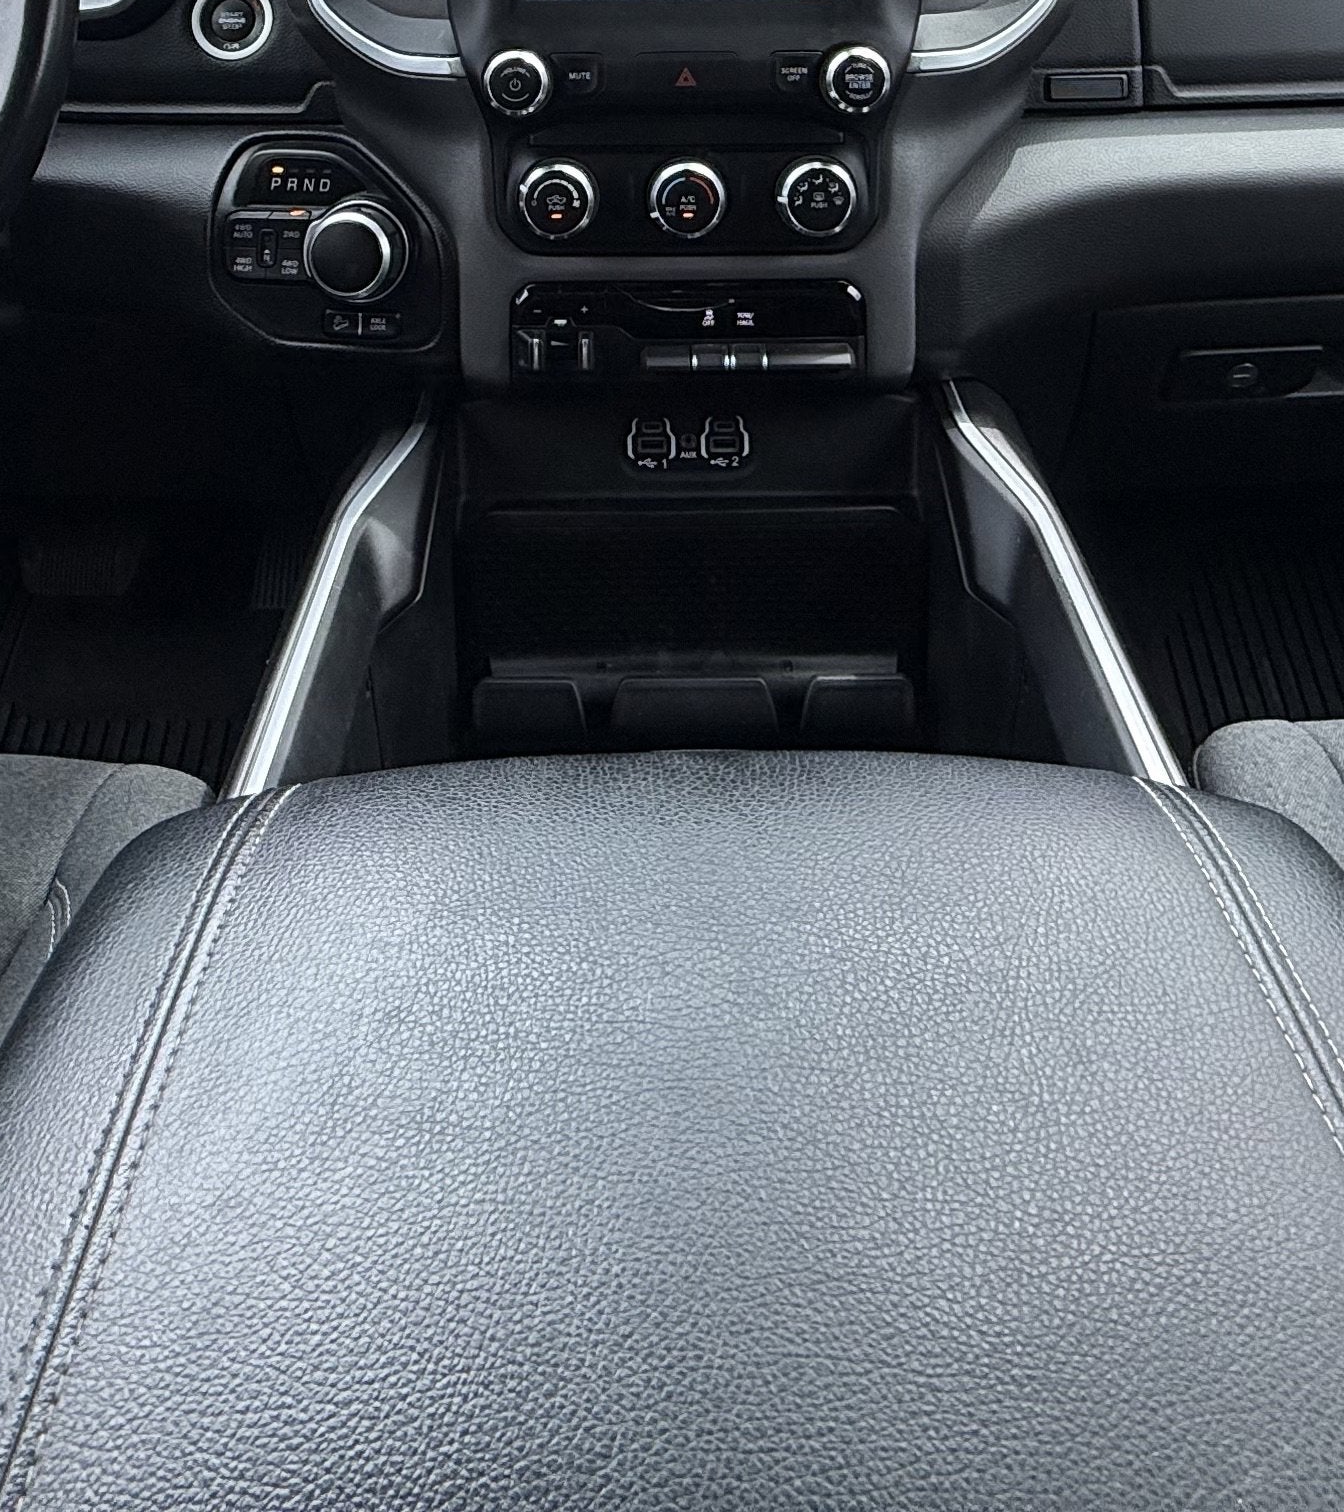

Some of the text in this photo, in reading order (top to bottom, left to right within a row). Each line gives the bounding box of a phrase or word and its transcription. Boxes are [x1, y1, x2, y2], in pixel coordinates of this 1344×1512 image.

[780, 66, 809, 75] SCREEN
[568, 71, 592, 80] MUTE
[786, 74, 801, 82] OFF
[681, 195, 696, 203] A/C
[810, 201, 828, 209] PUSH
[232, 231, 253, 239] AUTO
[234, 256, 253, 264] 4WD
[232, 264, 253, 272] HIGH
[280, 267, 299, 275] LOW
[701, 319, 715, 327] OFF
[680, 451, 697, 459] AUX
